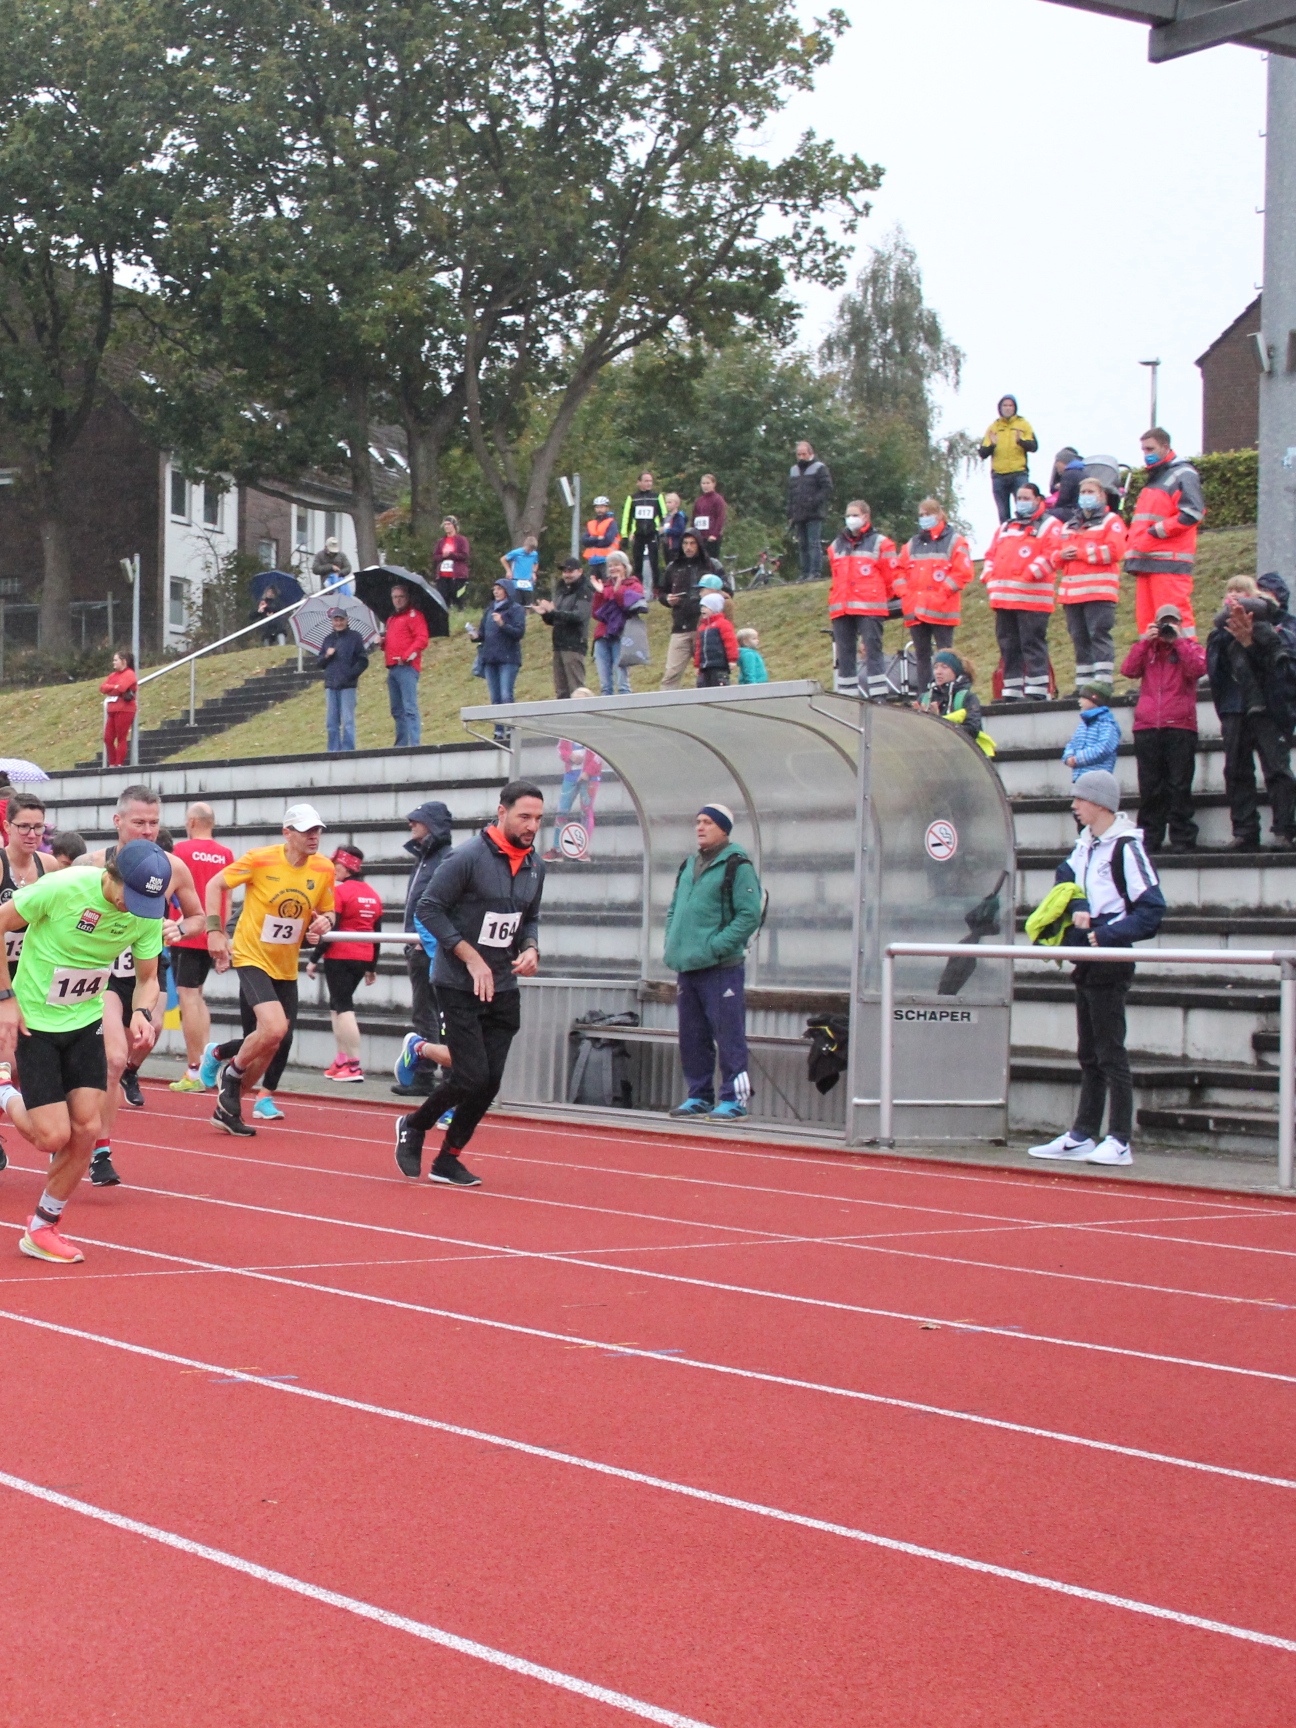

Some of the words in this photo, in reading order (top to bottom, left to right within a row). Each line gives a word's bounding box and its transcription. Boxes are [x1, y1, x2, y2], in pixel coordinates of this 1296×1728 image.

[637, 509, 651, 517] 417
[192, 851, 226, 864] COACH
[83, 909, 100, 920] Auto
[77, 923, 93, 932] Lass
[272, 924, 293, 939] 73
[58, 977, 102, 998] 144
